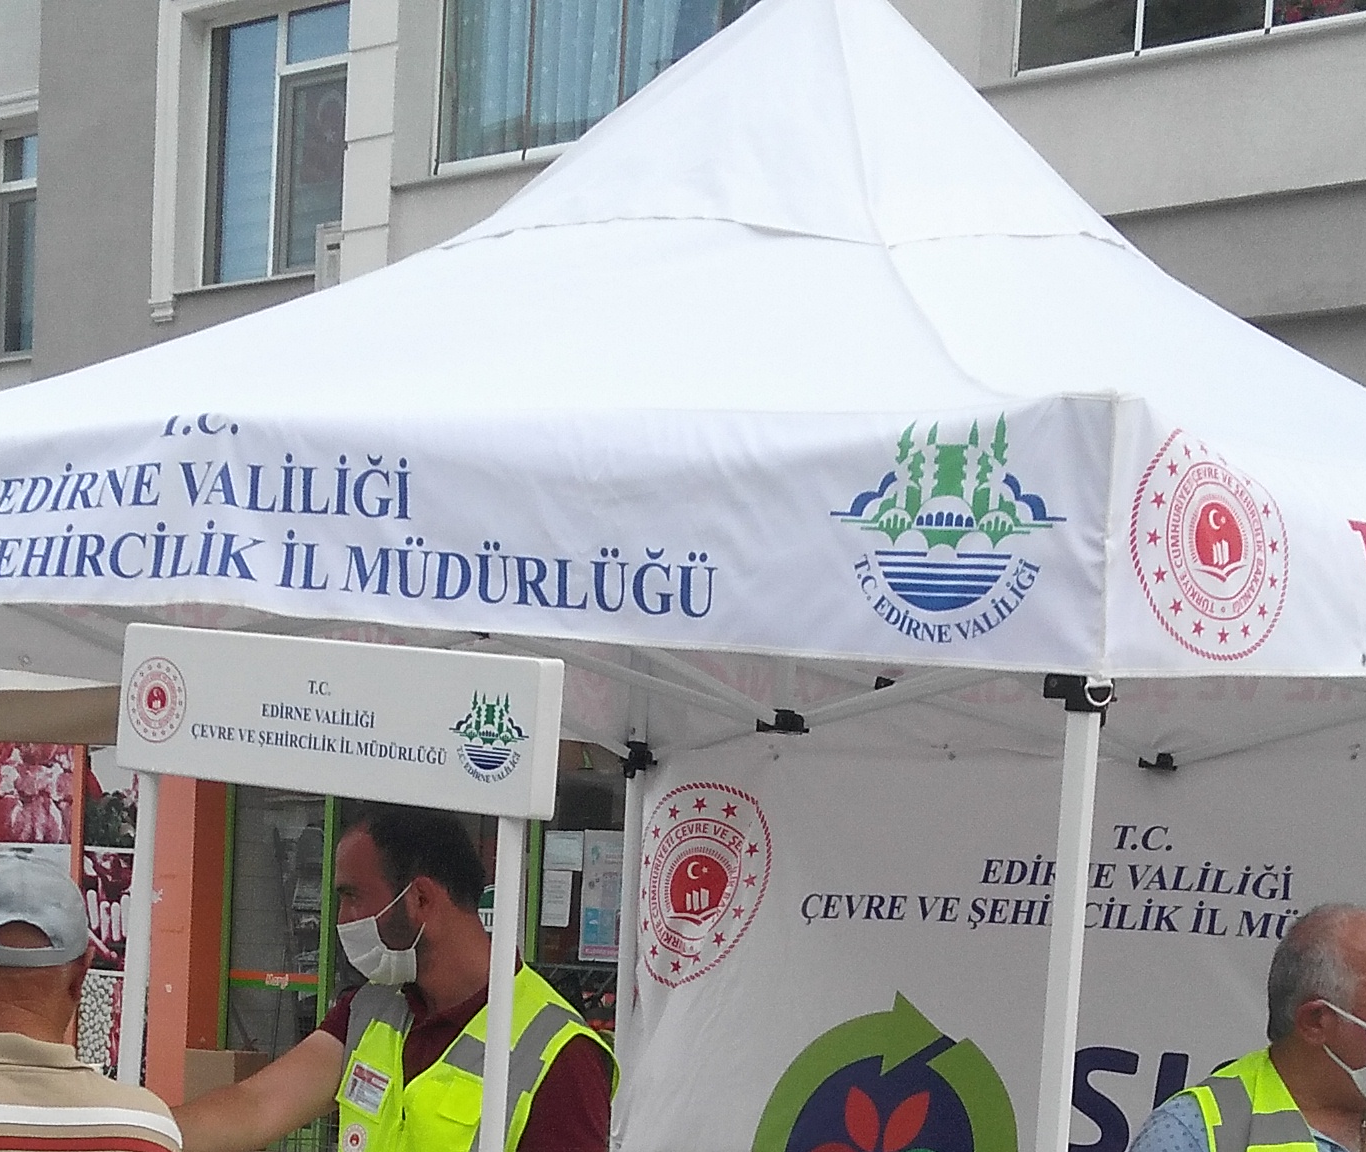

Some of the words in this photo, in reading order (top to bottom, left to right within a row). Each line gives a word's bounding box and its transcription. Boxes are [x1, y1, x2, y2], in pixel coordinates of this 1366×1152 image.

[178, 452, 413, 520] VALİLİĞİ
[274, 529, 330, 592] İL
[339, 535, 719, 621] MÜDÜRLÜĞÜ
[872, 594, 953, 643] EDİRNE
[954, 558, 1042, 641] VALİLİĞİ
[308, 679, 332, 696] T.C.
[261, 702, 312, 723] EDİRNE
[314, 708, 376, 730] VALİLİĞİ
[190, 722, 236, 741] ÇEVRE
[238, 727, 256, 744] VE
[258, 730, 338, 754] ŞEHİRCİLİK
[339, 736, 354, 756] İL
[356, 740, 448, 767] MÜDÜRLÜĞÜ
[1112, 824, 1174, 852] T.C.
[1128, 861, 1295, 901] VALİLİĞİ
[801, 892, 908, 926] ÇEVRE
[917, 896, 961, 923] VE
[966, 893, 1180, 934] ŞEHİCİLİK
[1192, 900, 1229, 938] İL
